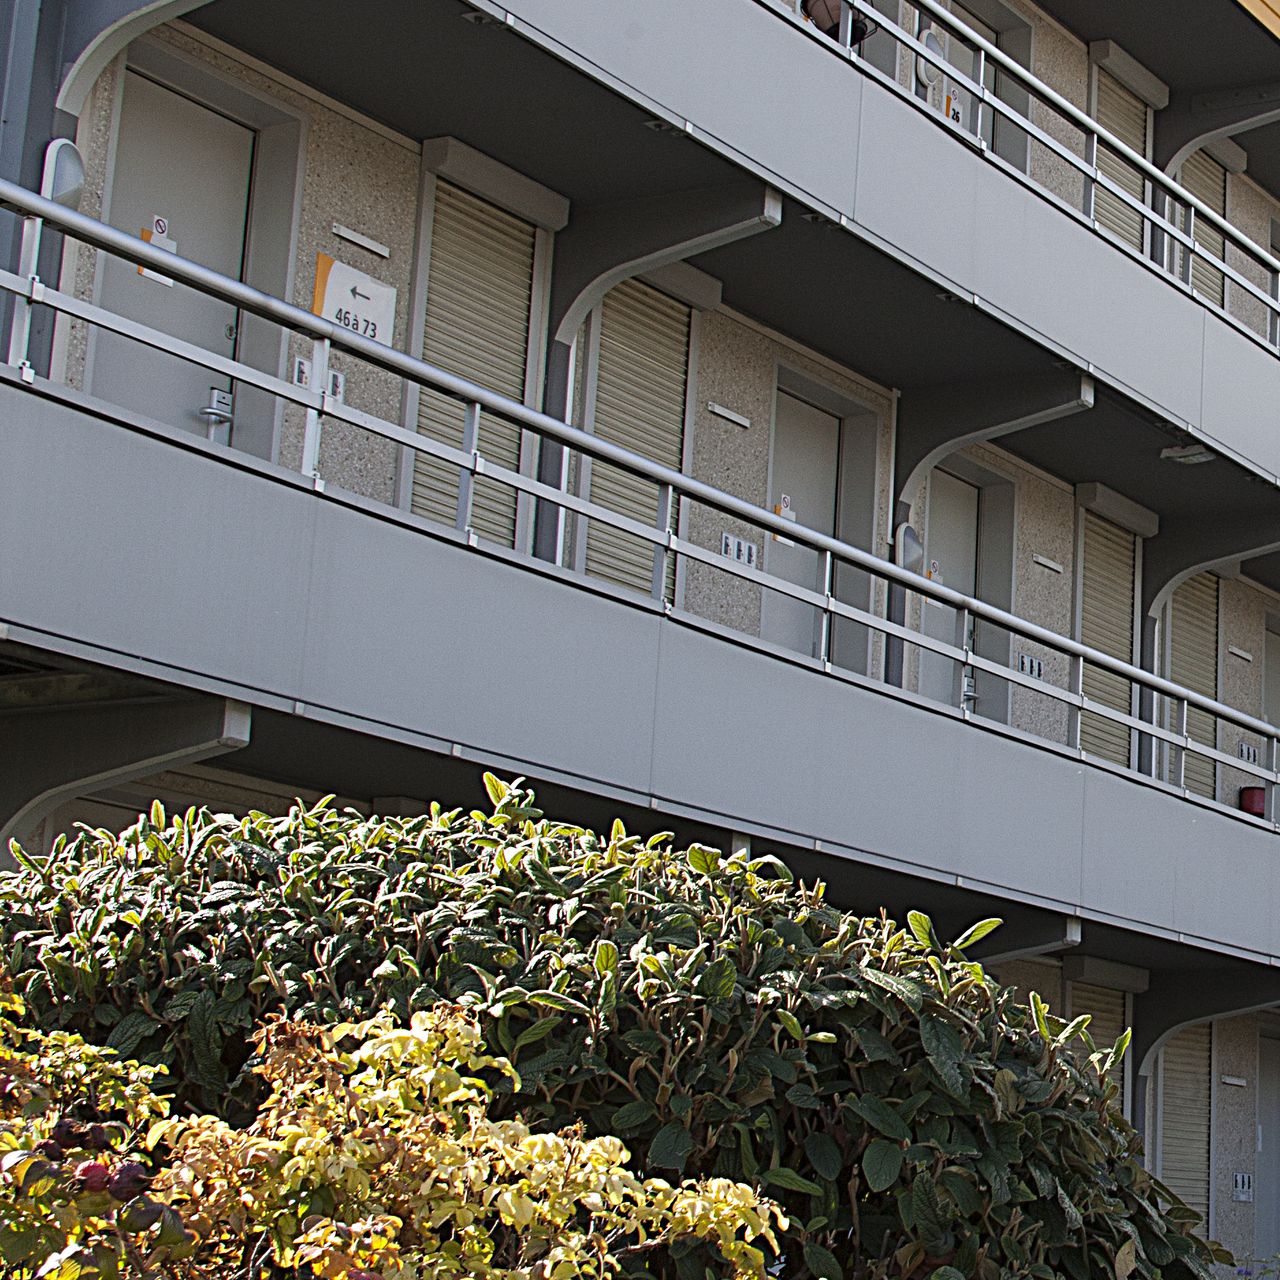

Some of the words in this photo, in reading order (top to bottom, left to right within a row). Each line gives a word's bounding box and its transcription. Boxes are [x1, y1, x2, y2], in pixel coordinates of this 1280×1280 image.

[951, 107, 960, 123] 26
[335, 307, 351, 327] 46
[352, 313, 359, 331] à
[363, 318, 377, 338] 73
